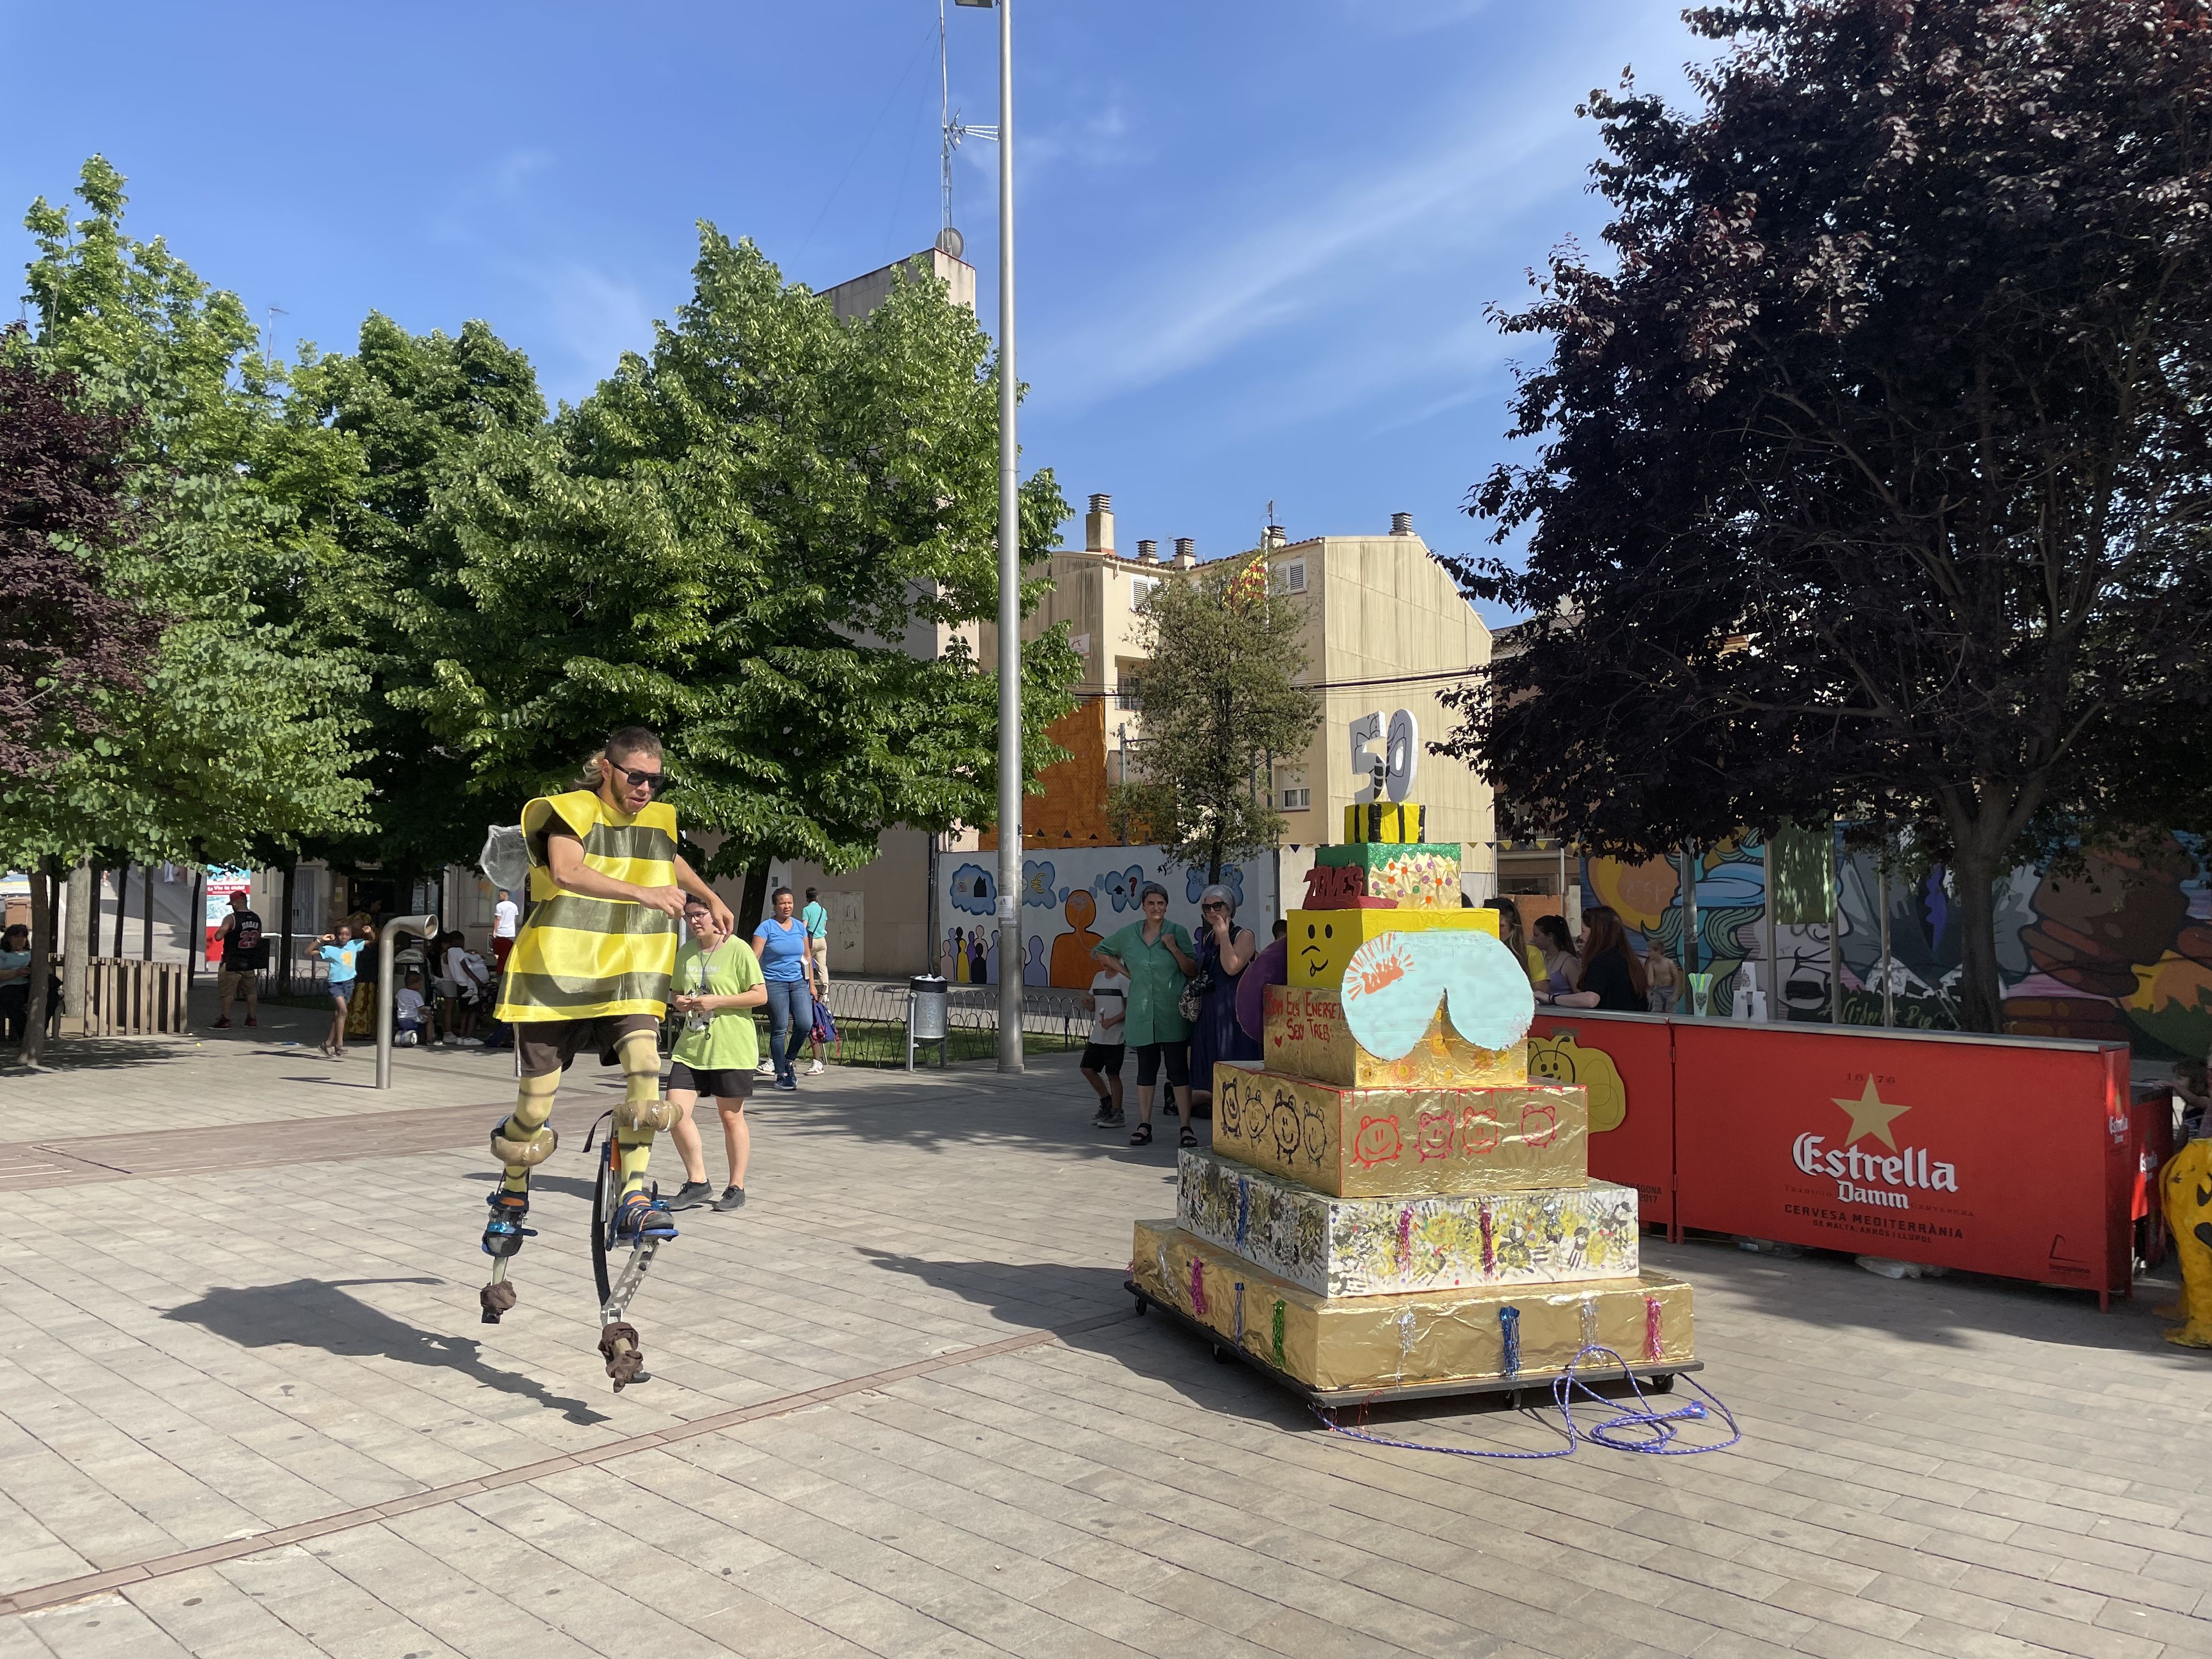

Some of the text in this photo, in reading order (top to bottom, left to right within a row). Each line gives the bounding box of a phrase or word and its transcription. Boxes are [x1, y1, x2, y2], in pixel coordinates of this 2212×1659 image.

[1349, 708, 1418, 803] 50
[238, 930, 259, 949] 23
[1792, 1132, 1959, 1193] Estrella
[1639, 1193, 1658, 1204] 2017
[1836, 1180, 1910, 1209] Damm
[1785, 1204, 1964, 1239] CERVESA MEDITERRÀNIA
